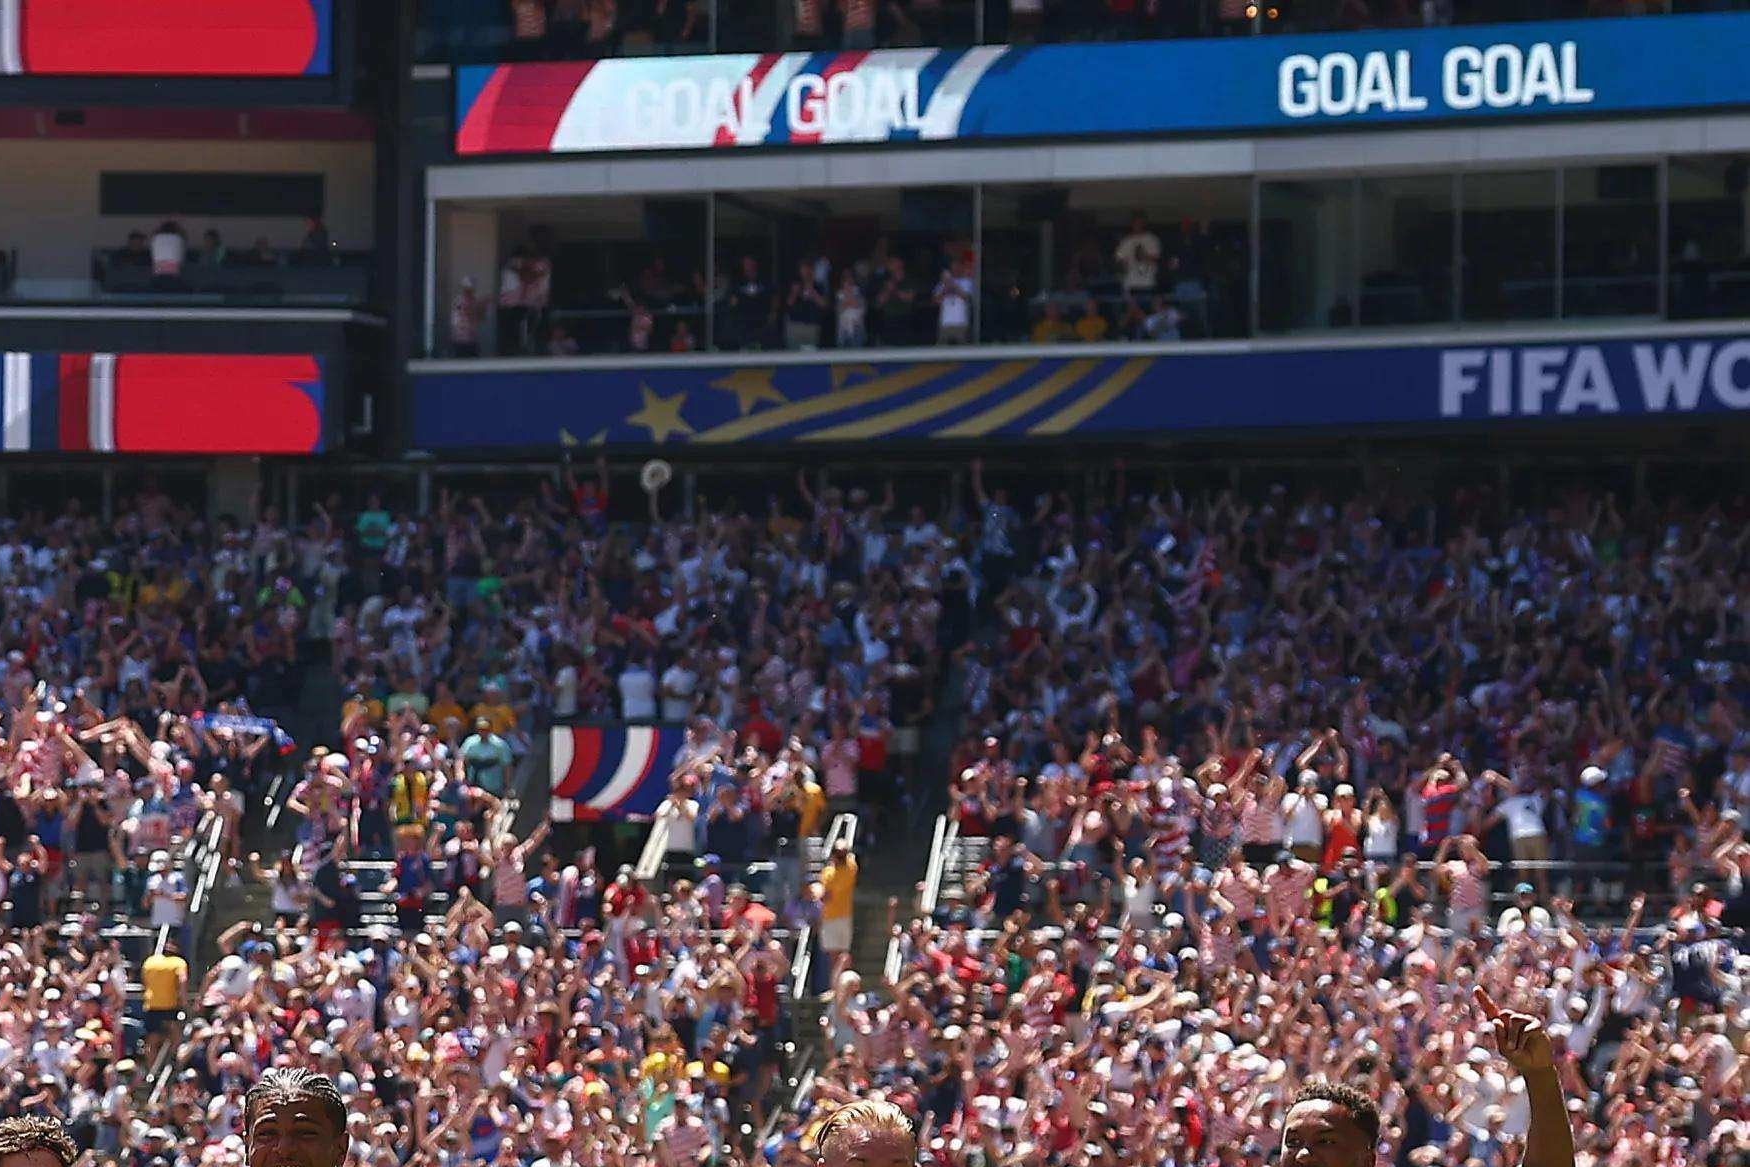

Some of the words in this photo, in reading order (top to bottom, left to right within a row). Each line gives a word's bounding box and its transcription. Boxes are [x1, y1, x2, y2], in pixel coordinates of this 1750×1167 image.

[627, 73, 772, 136] GOAL
[787, 66, 934, 134] GOAL
[1277, 50, 1428, 118] GOAL
[1442, 40, 1594, 109] GOAL
[1438, 346, 1619, 417] FIFA
